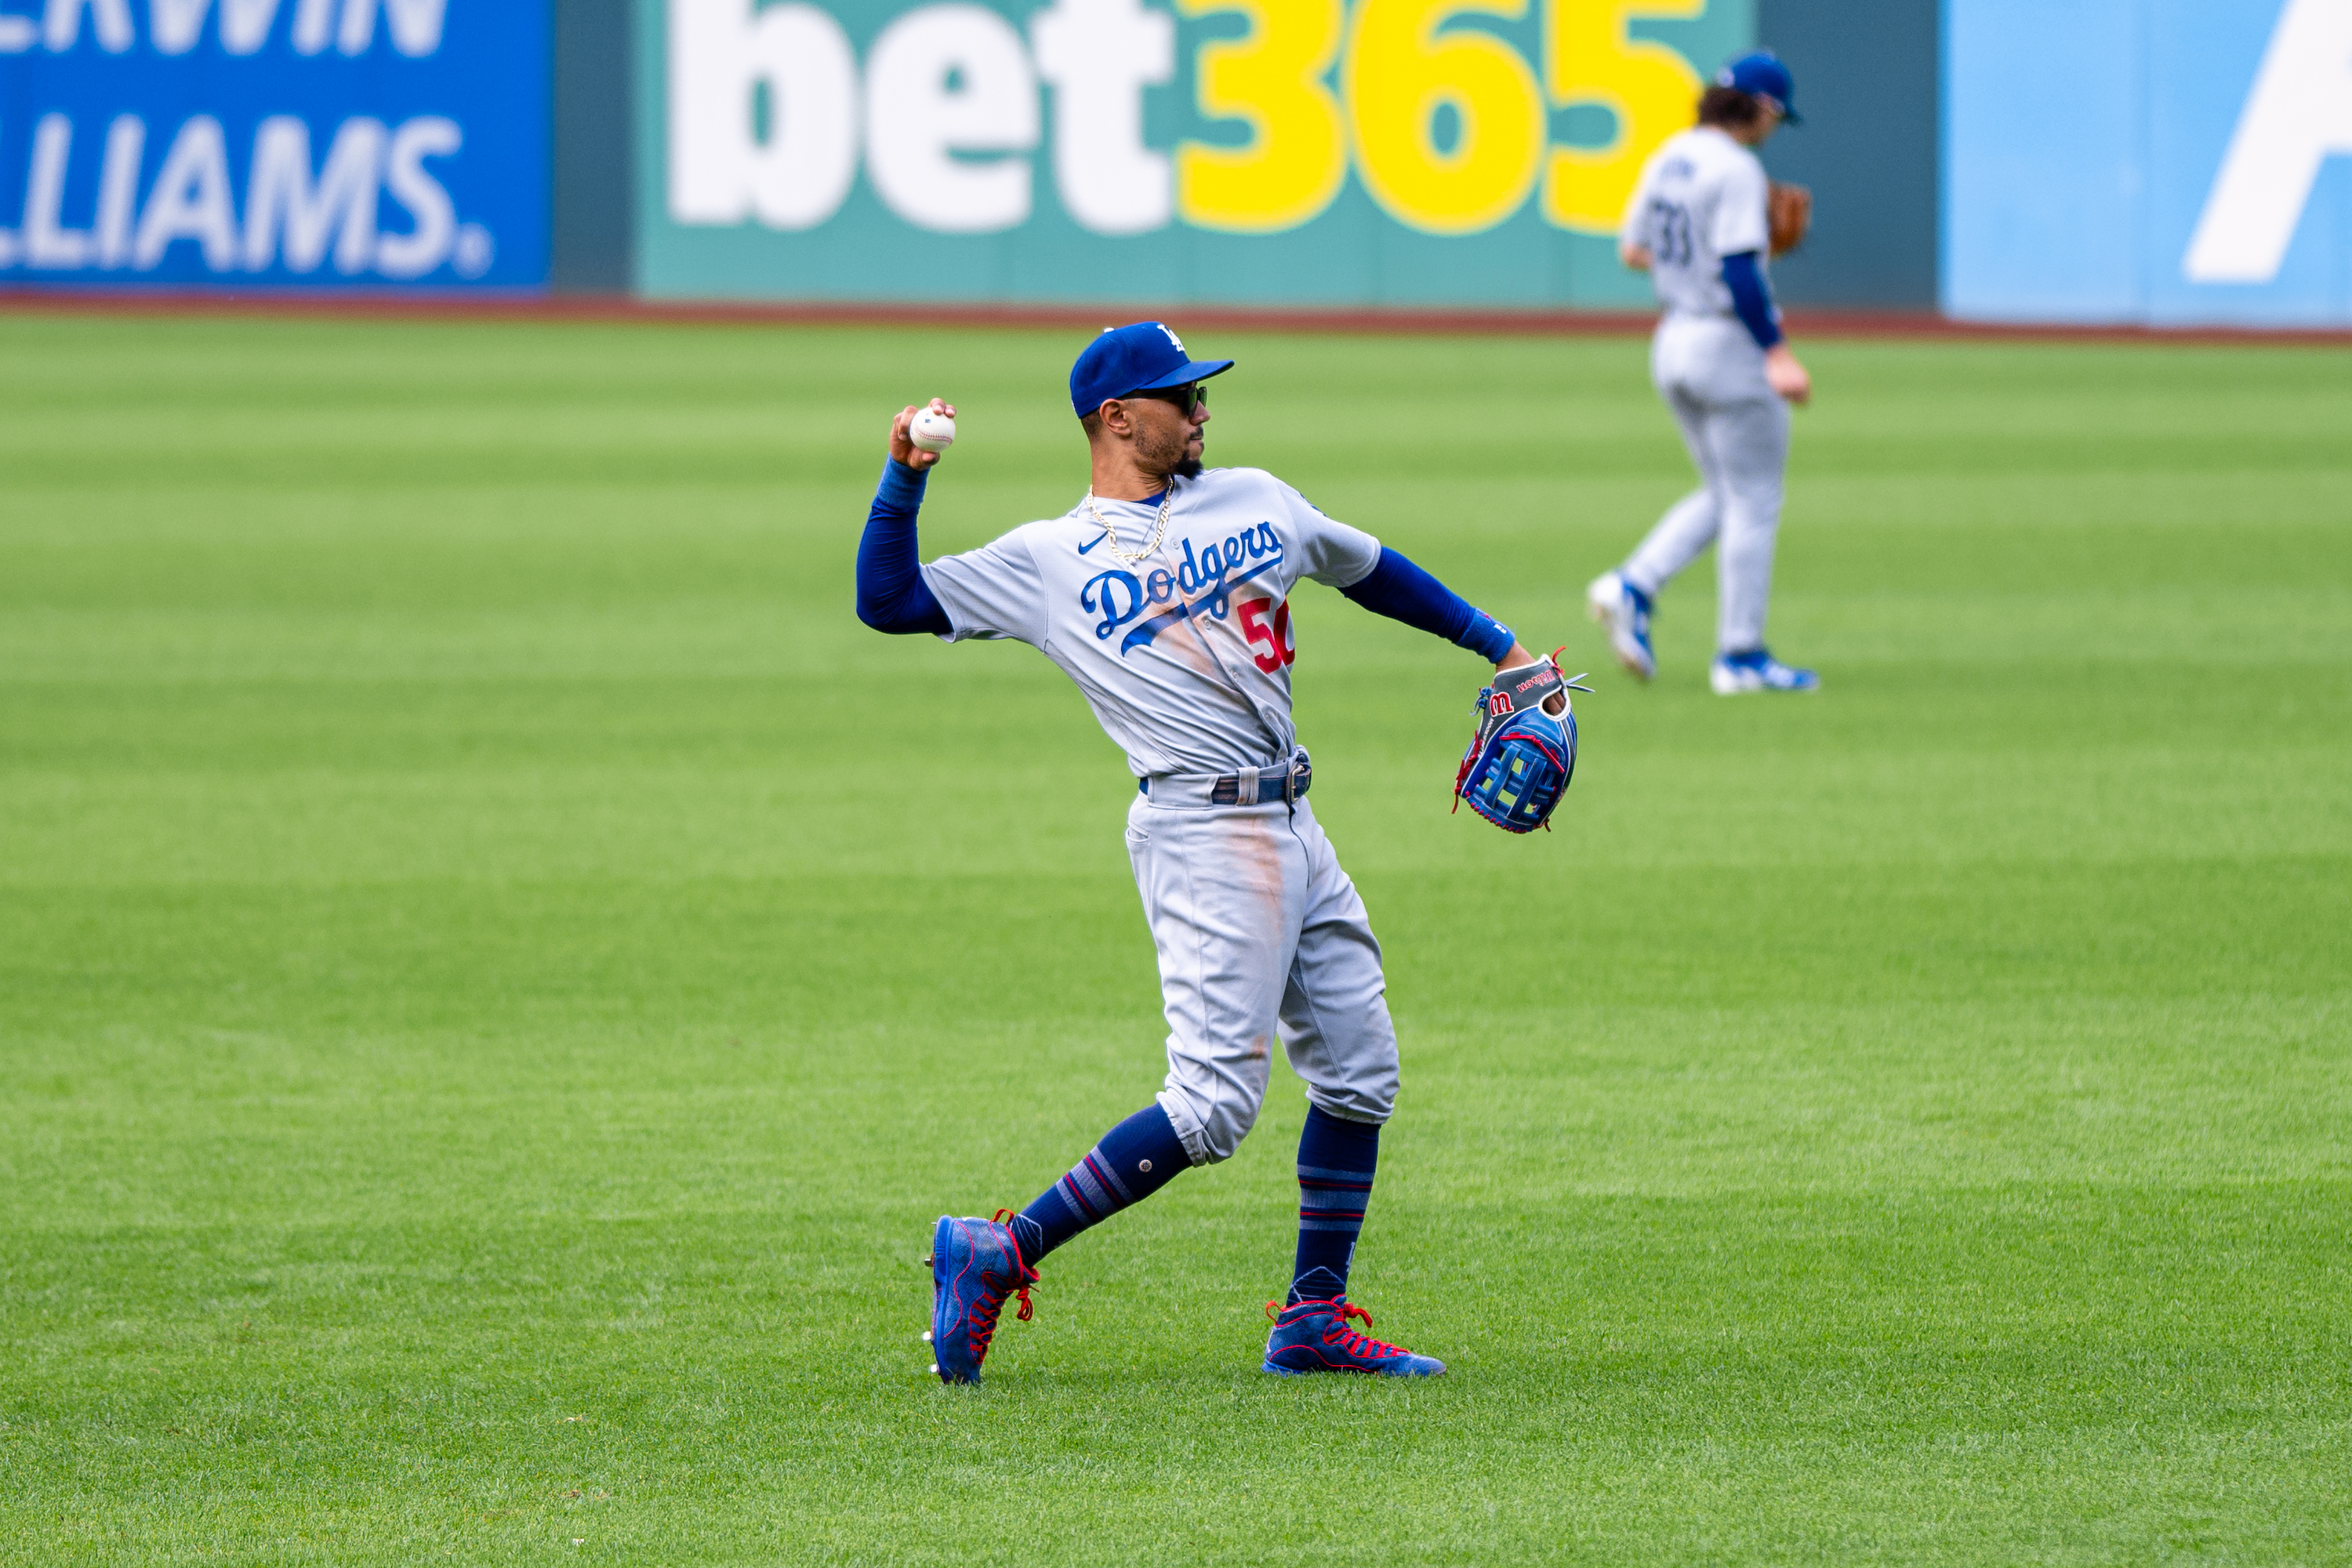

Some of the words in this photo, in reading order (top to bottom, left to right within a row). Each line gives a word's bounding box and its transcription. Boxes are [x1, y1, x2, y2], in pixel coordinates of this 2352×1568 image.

[666, 0, 1704, 235] bet365
[1080, 521, 1284, 641] Dodgers
[1516, 670, 1556, 693] Wilson
